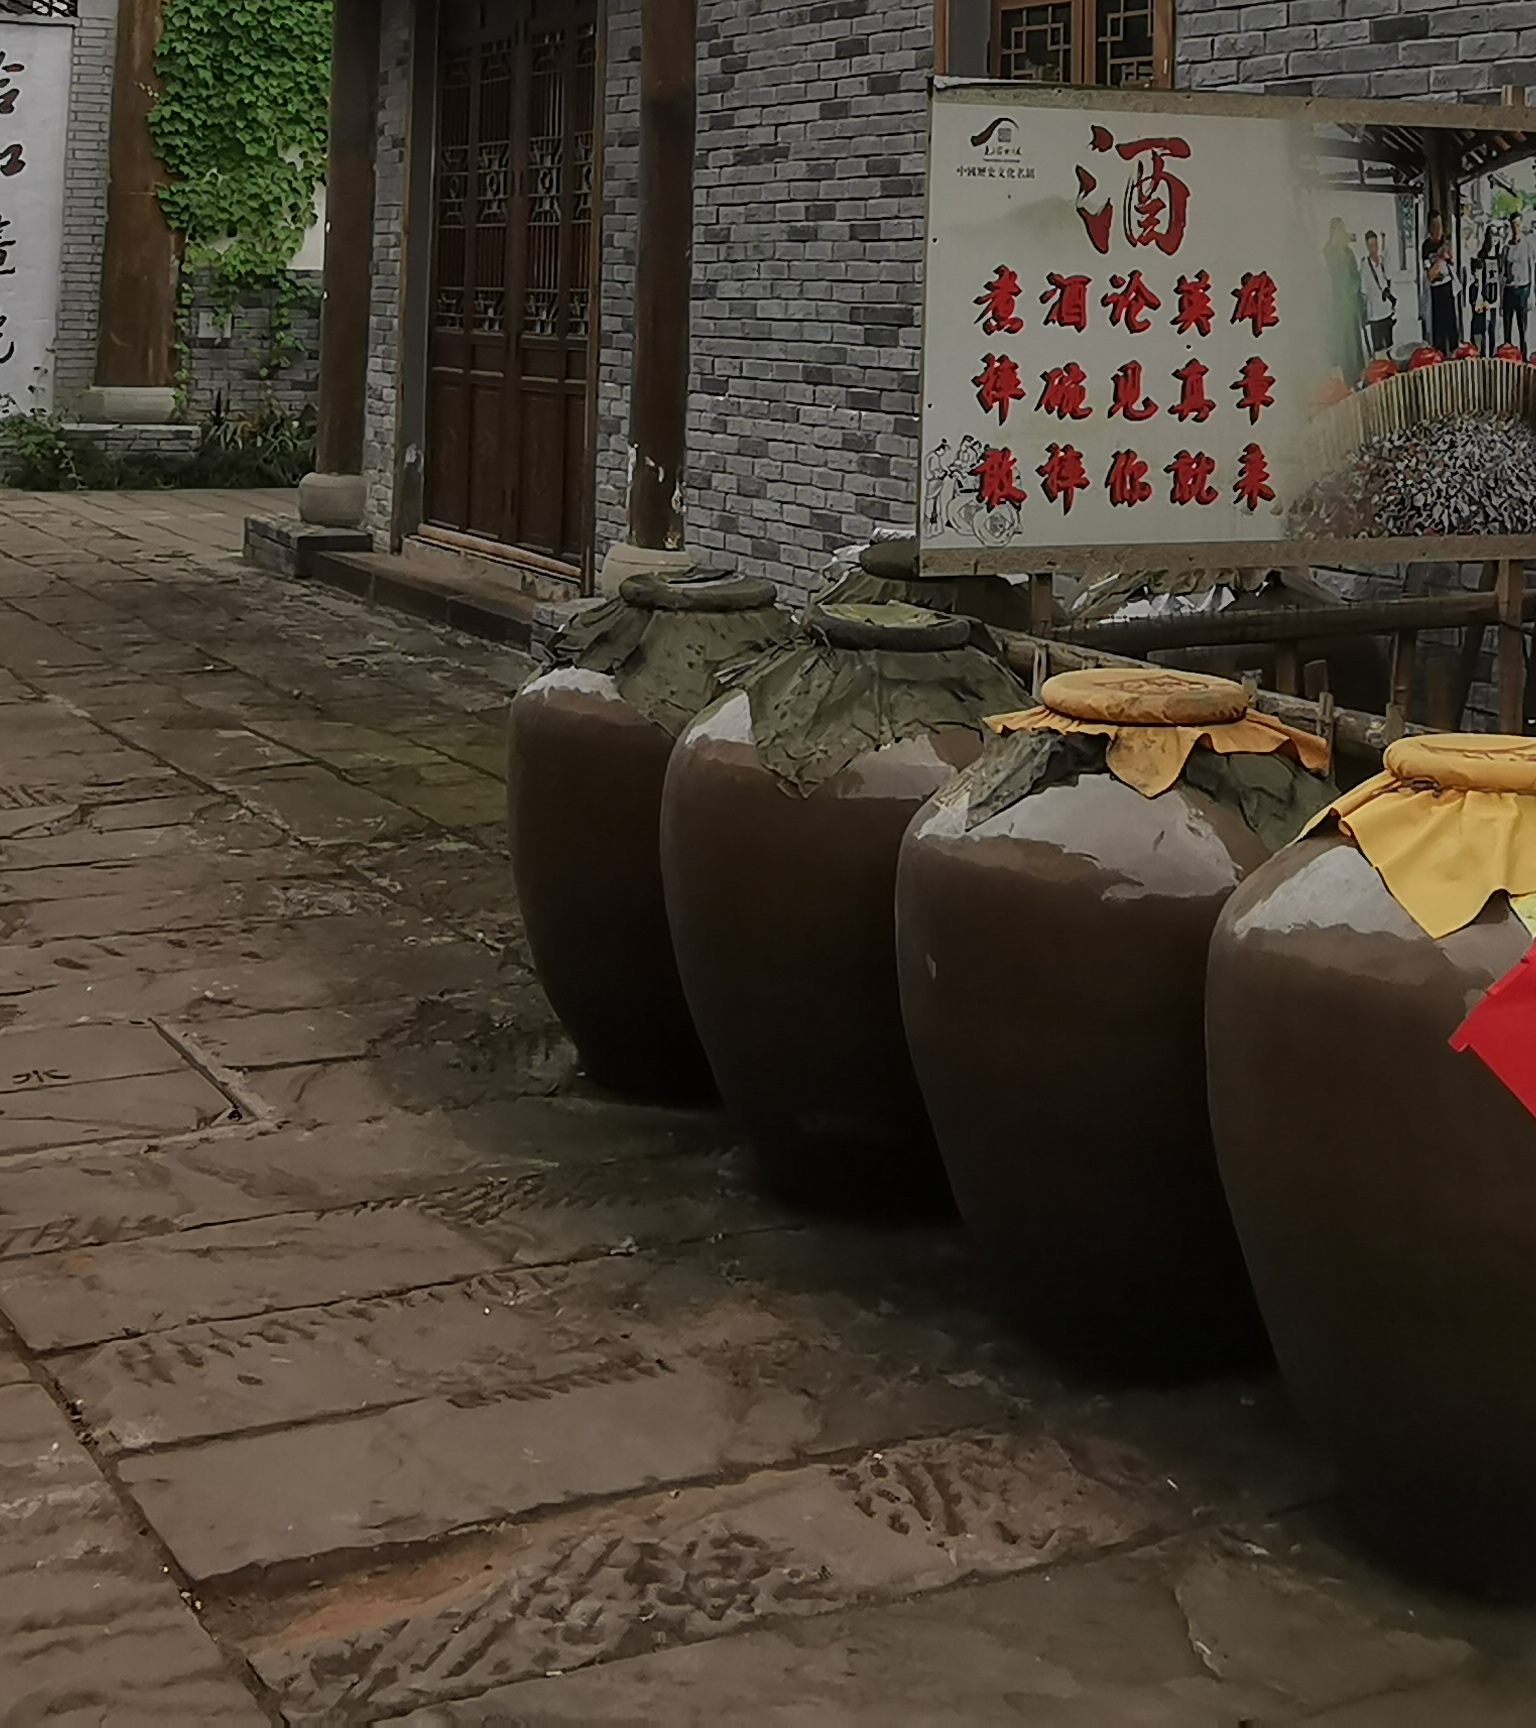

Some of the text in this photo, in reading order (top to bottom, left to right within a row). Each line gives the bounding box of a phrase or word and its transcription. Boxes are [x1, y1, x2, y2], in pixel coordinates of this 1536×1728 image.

[1075, 124, 1191, 256] 酒
[973, 264, 1280, 337] 煮酒论英雄
[971, 353, 1276, 426] 摔碗见真章
[972, 443, 1276, 516] 敢摔你就来
